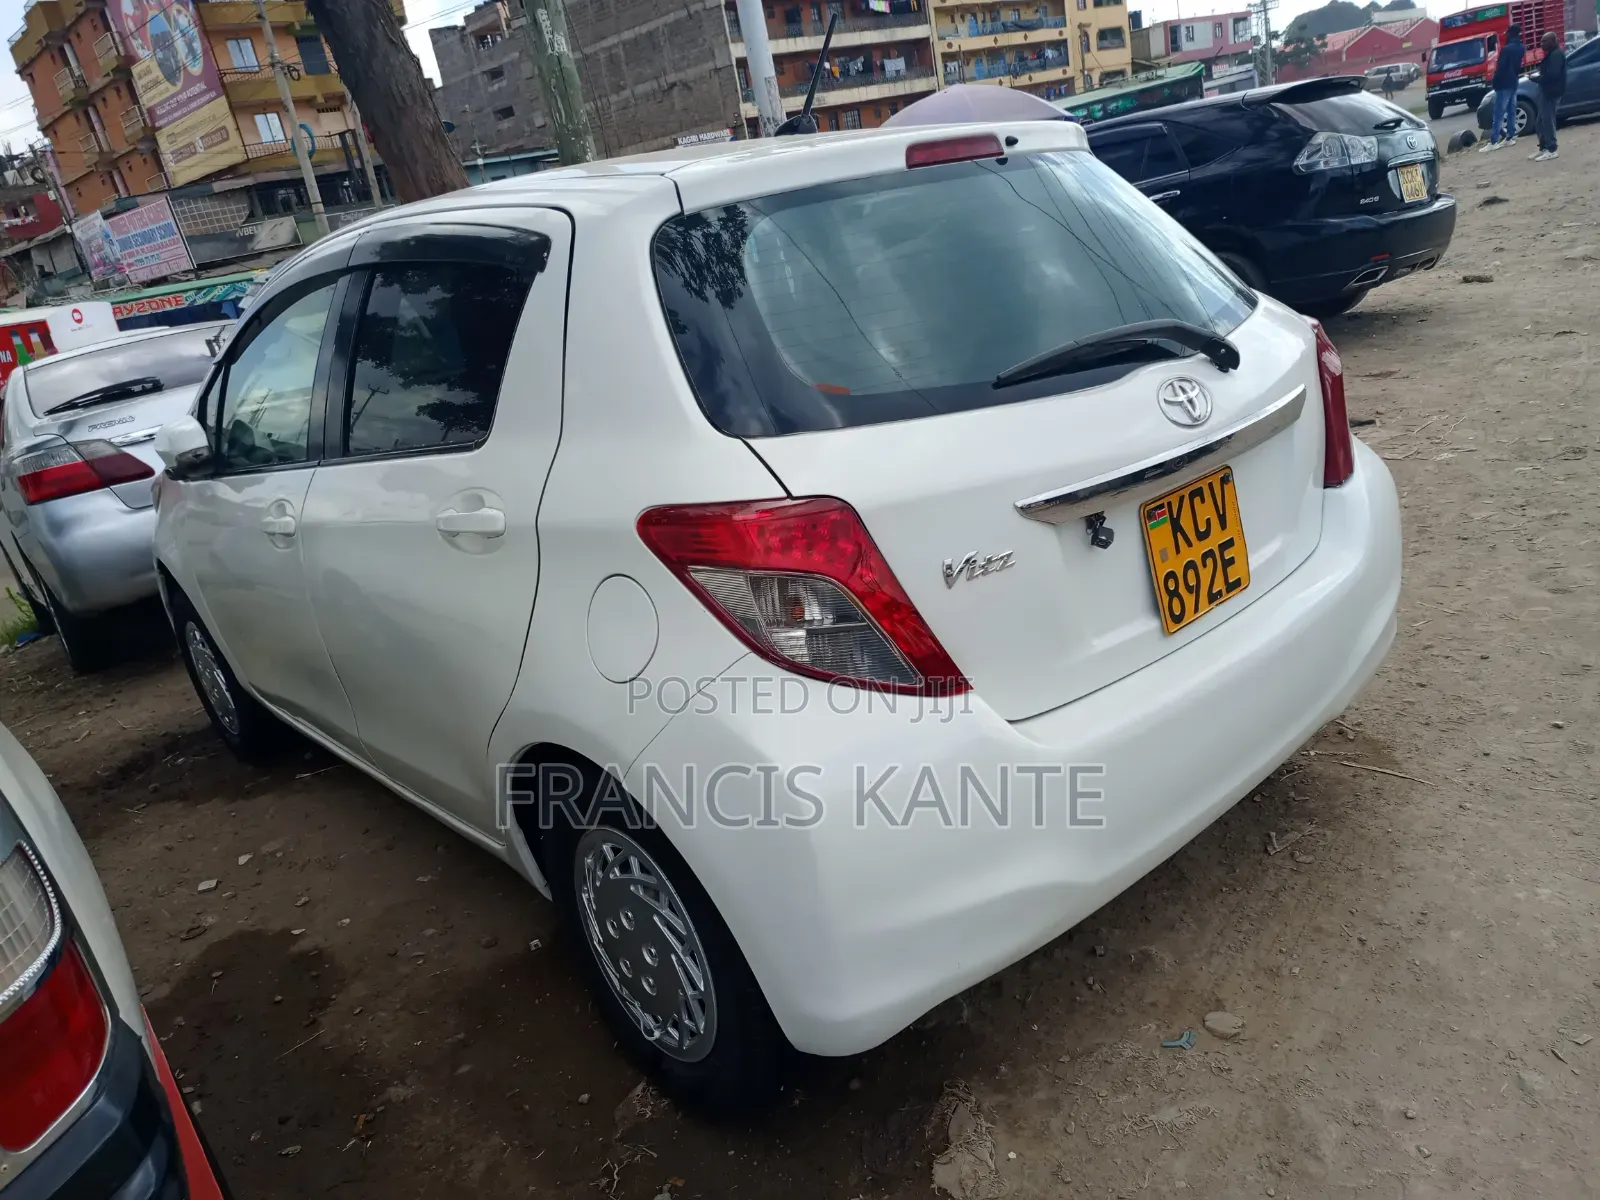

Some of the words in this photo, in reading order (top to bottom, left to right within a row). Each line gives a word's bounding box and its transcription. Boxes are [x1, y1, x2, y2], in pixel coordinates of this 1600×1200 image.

[677, 134, 700, 145] KAGIRI
[699, 129, 731, 141] HARDWARE
[88, 415, 135, 432] PREMIO
[1167, 474, 1230, 555] KCV
[942, 550, 1017, 590] Vitz
[1163, 537, 1242, 625] 892E
